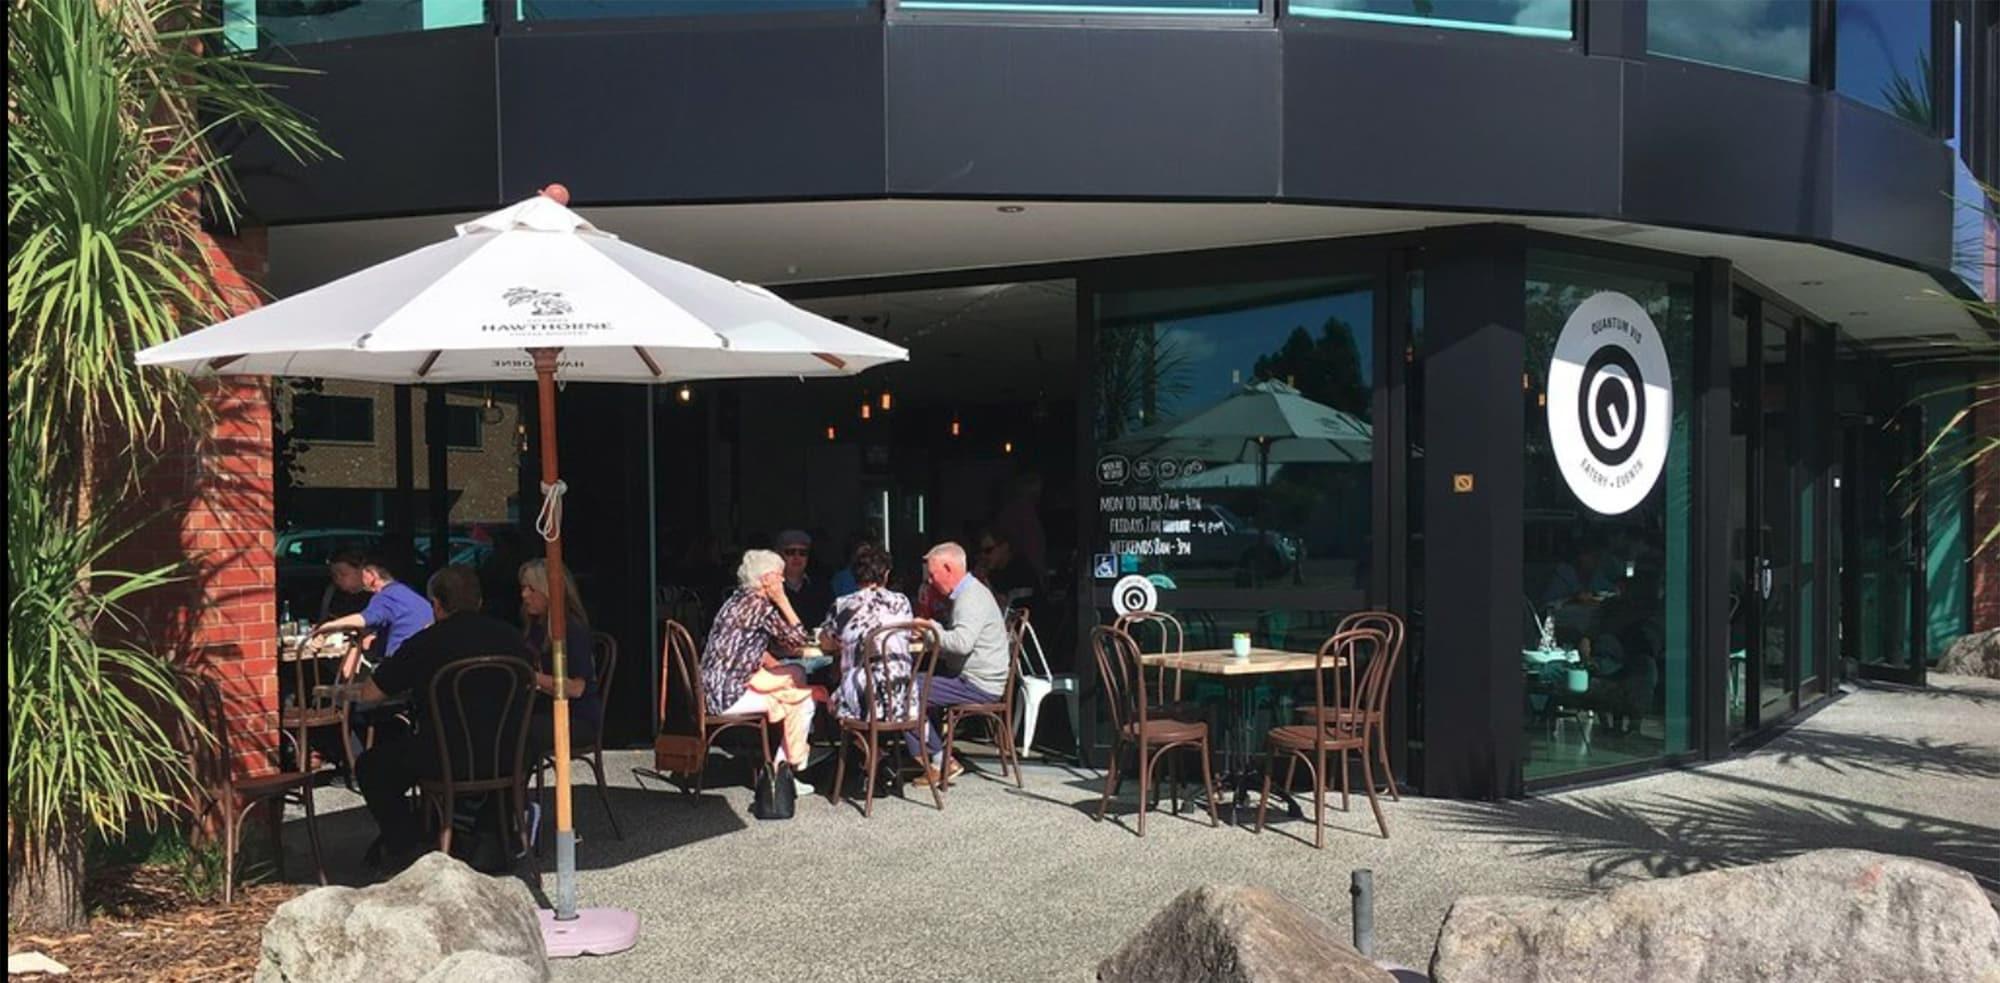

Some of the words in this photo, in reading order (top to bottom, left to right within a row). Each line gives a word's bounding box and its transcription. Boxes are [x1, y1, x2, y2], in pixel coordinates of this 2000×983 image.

[481, 322, 615, 331] HAWTHORNE
[1592, 317, 1629, 334] QUANTUM
[1580, 458, 1608, 487] EATERY
[1616, 459, 1643, 488] EVENTS
[1100, 496, 1122, 511] MON
[1125, 496, 1136, 511] TO
[1138, 496, 1162, 511] THURS
[1109, 518, 1144, 533] FRIDAYS
[1110, 539, 1153, 554] WEEKENDS
